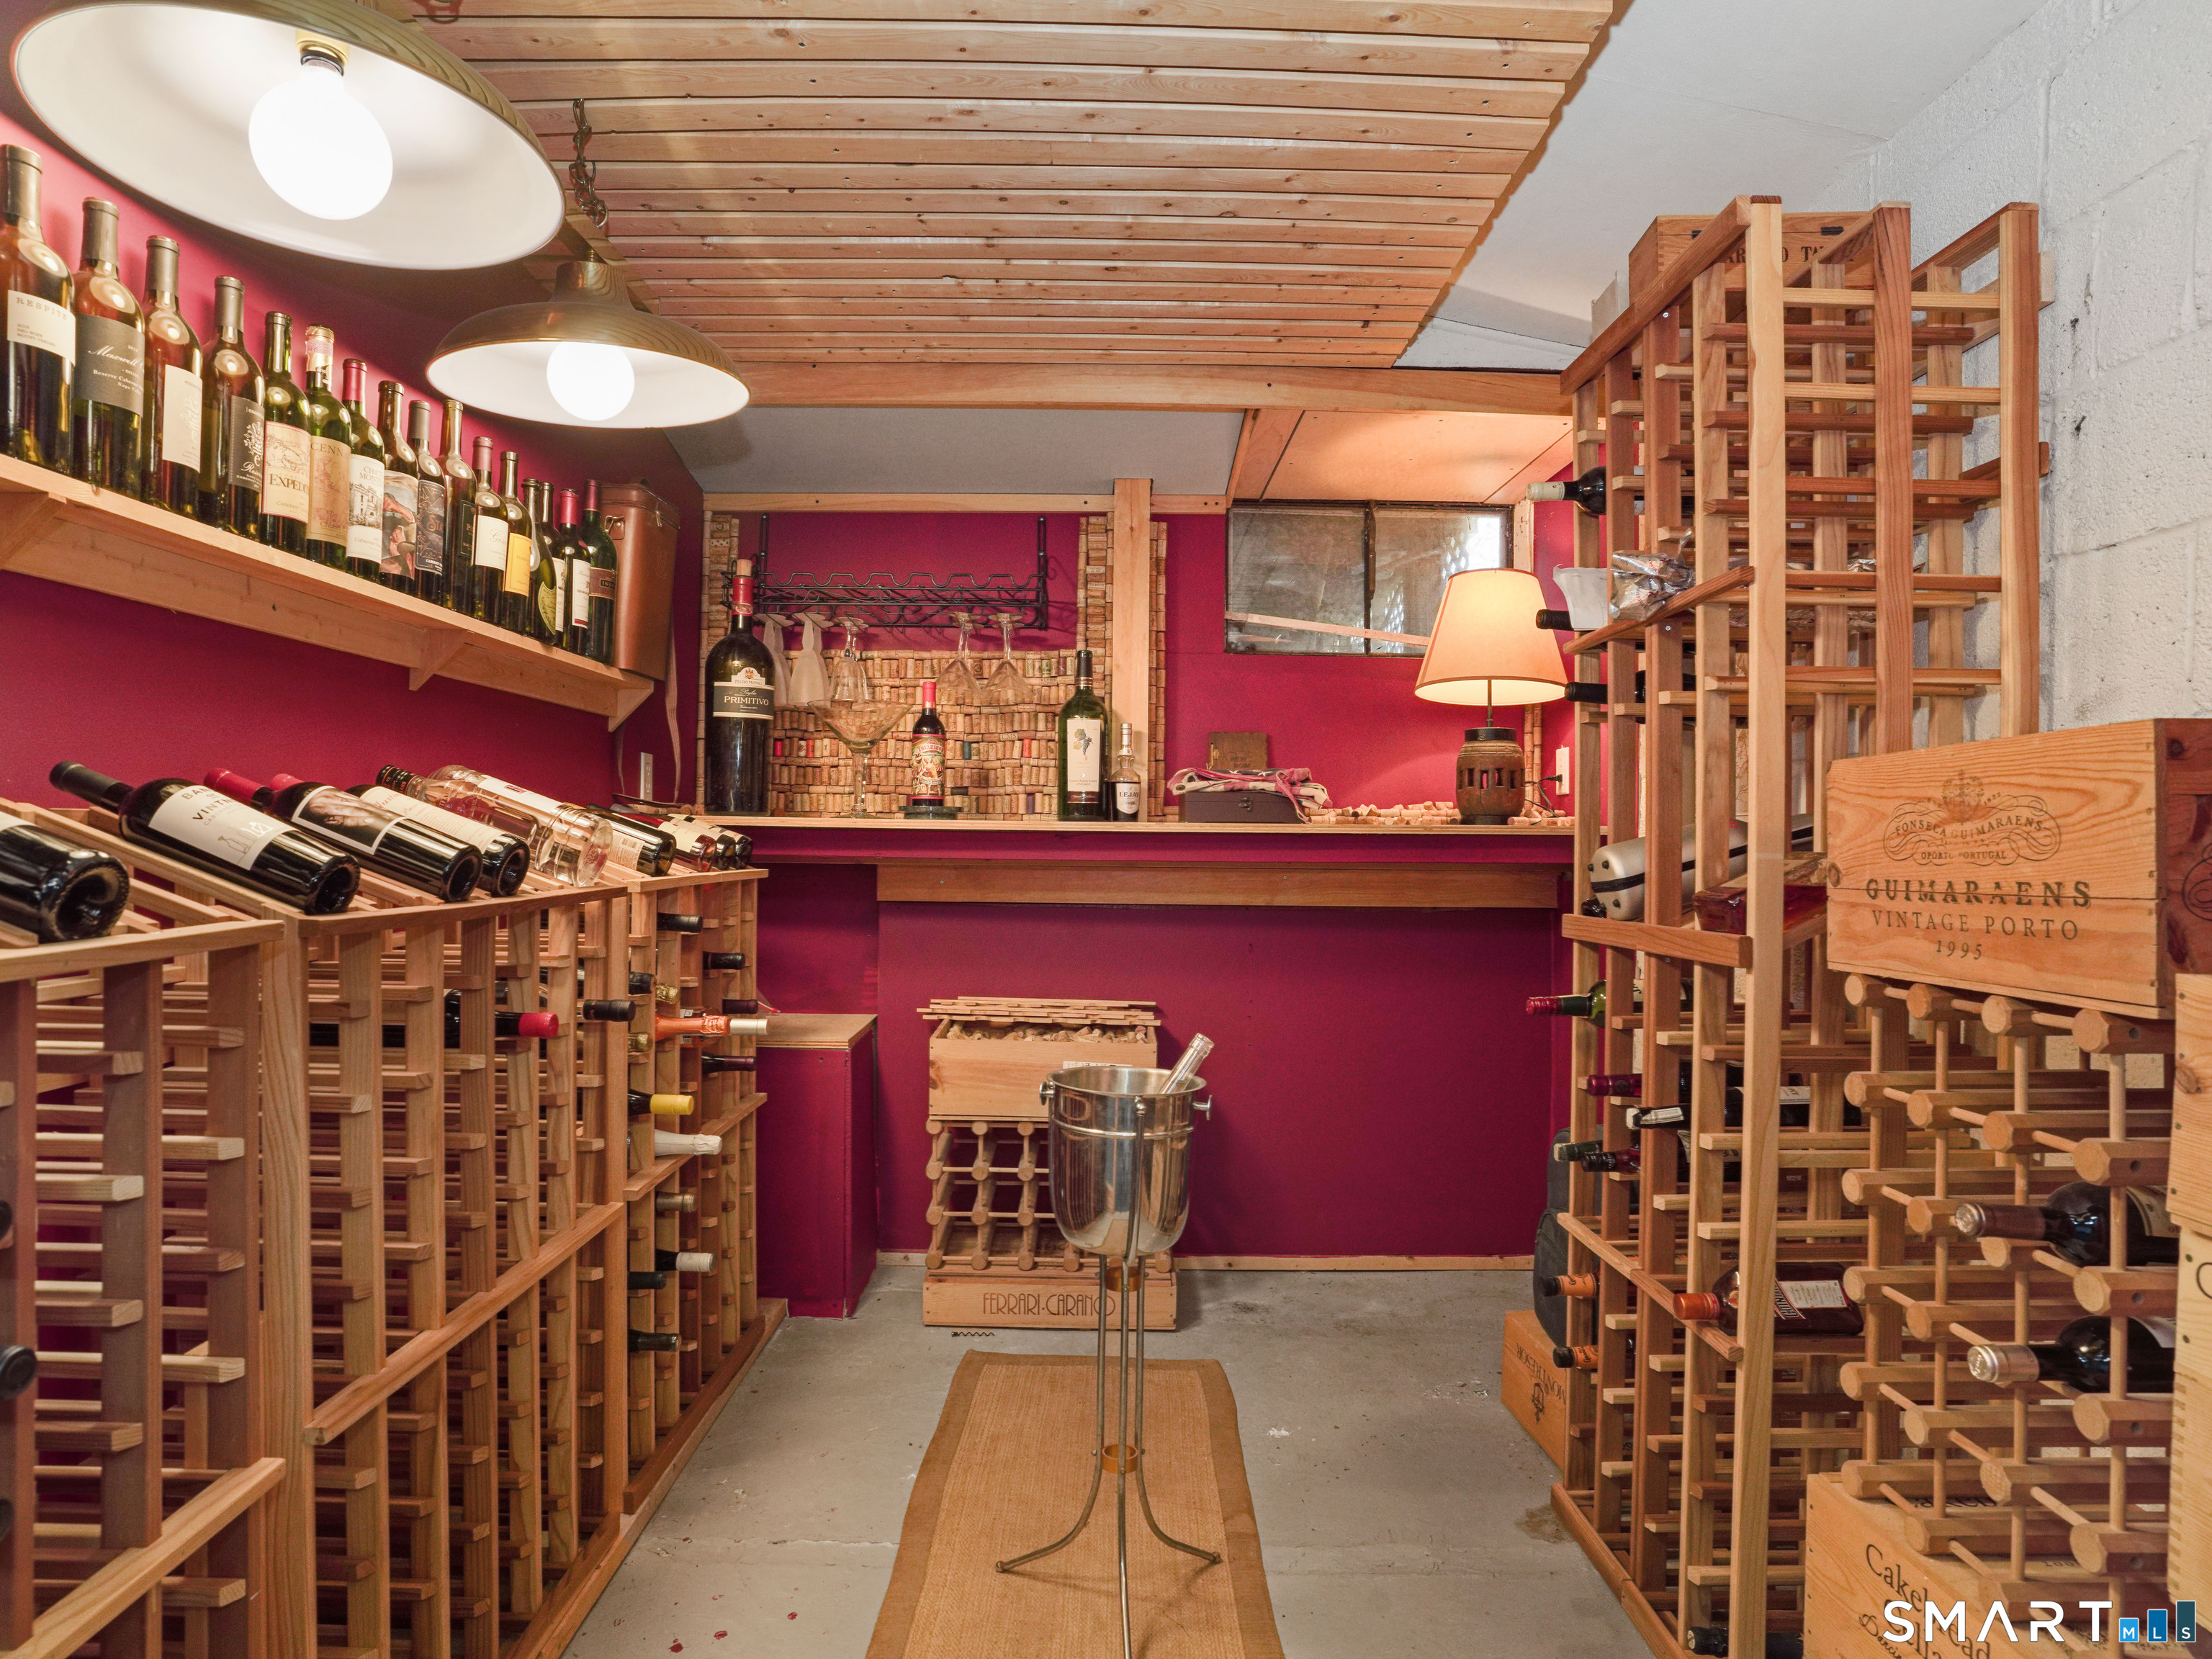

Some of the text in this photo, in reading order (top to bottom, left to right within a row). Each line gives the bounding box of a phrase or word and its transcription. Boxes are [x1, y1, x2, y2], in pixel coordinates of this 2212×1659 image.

[16, 297, 68, 320] RESPITE
[93, 369, 117, 379] Reserve
[724, 696, 769, 706] PRIMITIVO
[1894, 814, 2044, 840] FONSECA GUIMARAENS
[1866, 878, 2092, 908] GUIMARAENS
[1872, 910, 2078, 940] VINTAGE PORTO
[1936, 940, 1982, 960] 1995
